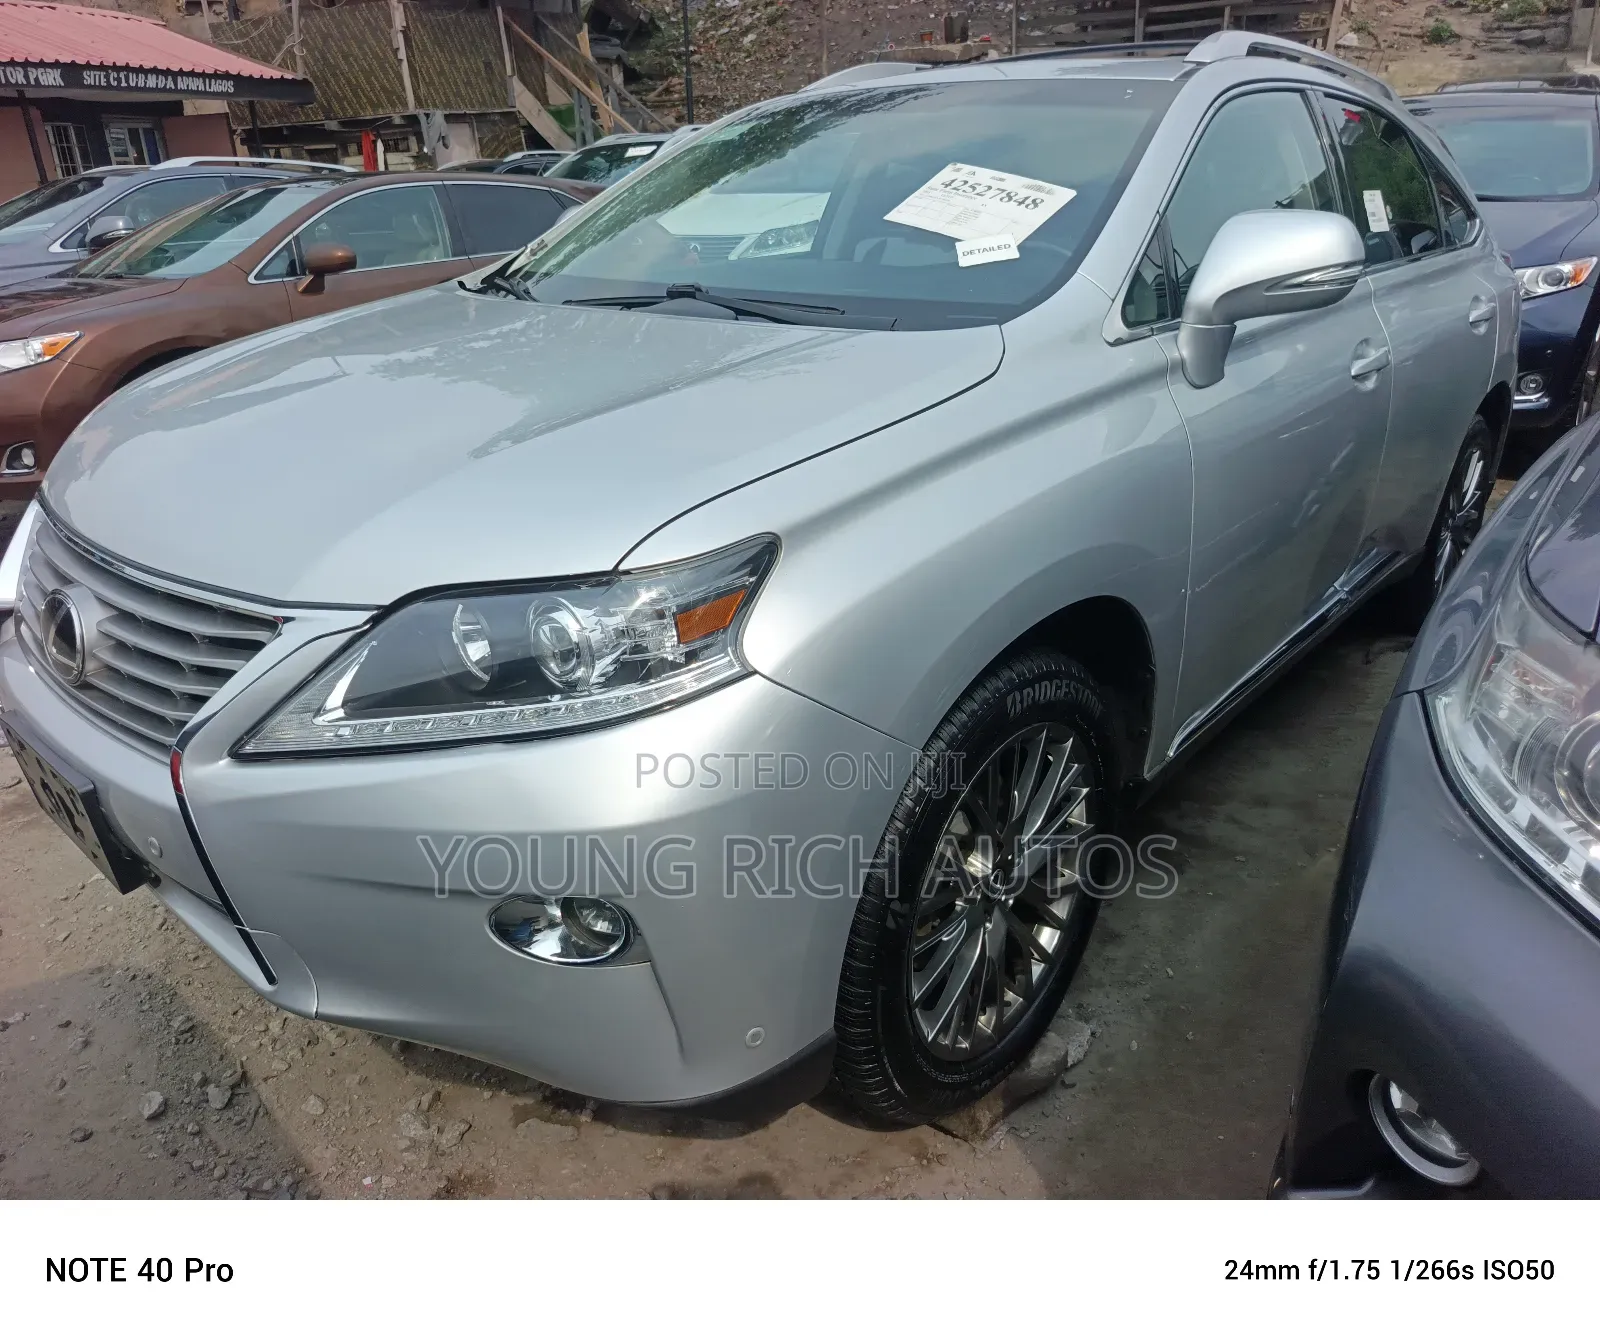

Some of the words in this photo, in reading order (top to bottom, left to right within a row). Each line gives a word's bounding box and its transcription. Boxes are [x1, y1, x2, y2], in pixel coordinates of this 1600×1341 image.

[83, 70, 107, 86] SITE
[177, 76, 205, 91] APAPA
[206, 78, 235, 93] LAGOS
[940, 177, 1045, 211] 42527848
[962, 243, 1012, 257] DETAILED
